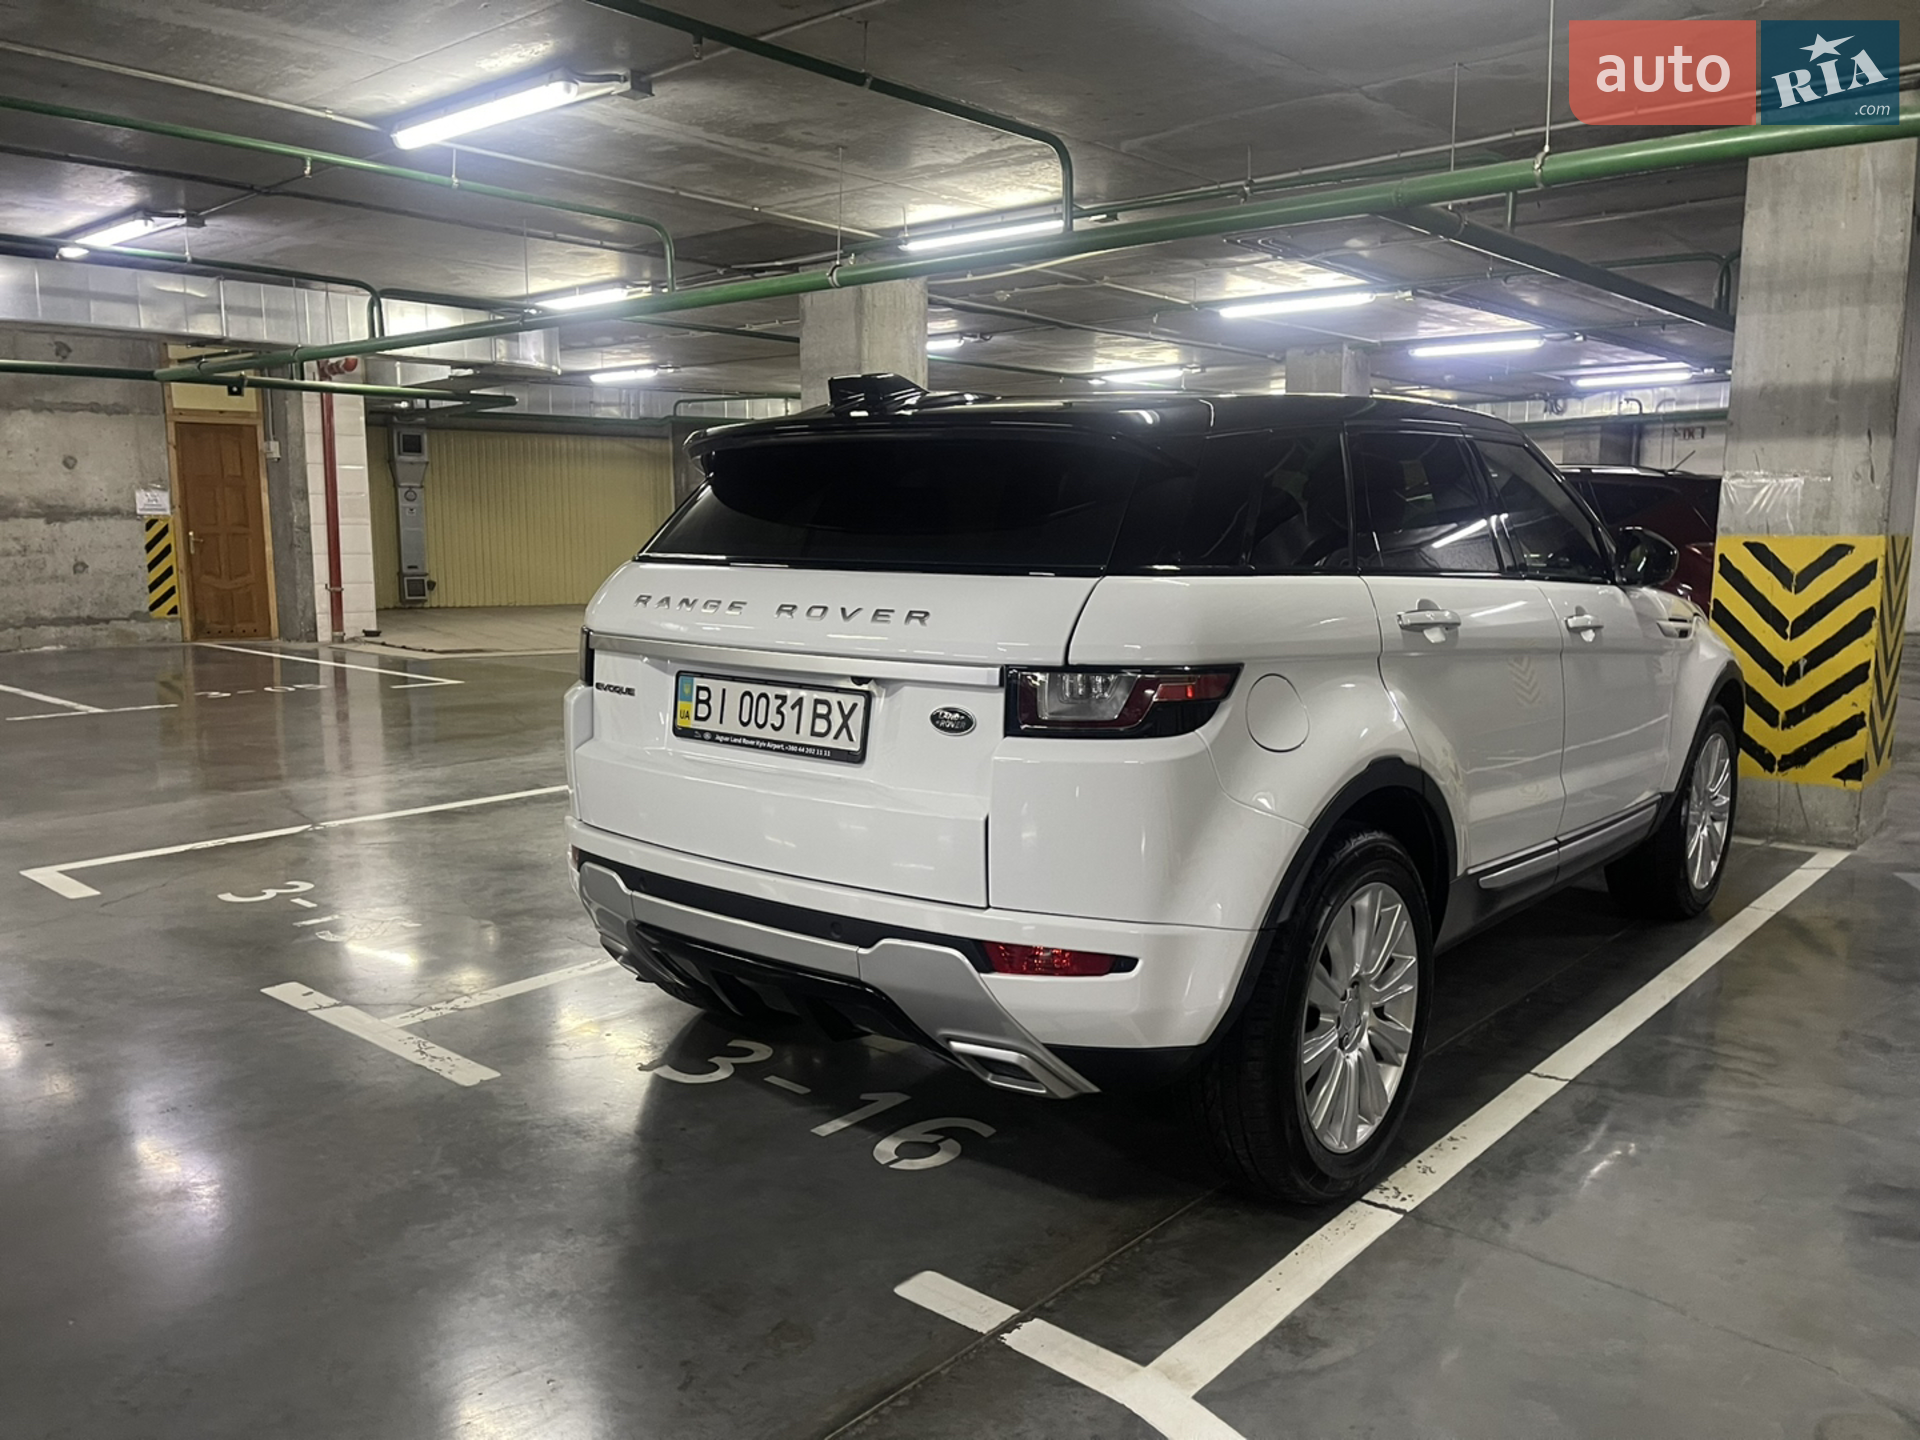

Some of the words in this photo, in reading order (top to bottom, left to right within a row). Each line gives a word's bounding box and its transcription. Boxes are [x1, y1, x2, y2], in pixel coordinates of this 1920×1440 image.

[633, 594, 747, 616] RANGE
[773, 603, 931, 627] ROVER
[595, 682, 636, 697] EVOQUE
[679, 709, 691, 721] UA
[730, 736, 742, 744] Land
[742, 738, 756, 746] Rover
[637, 1038, 997, 1171] 3-16
